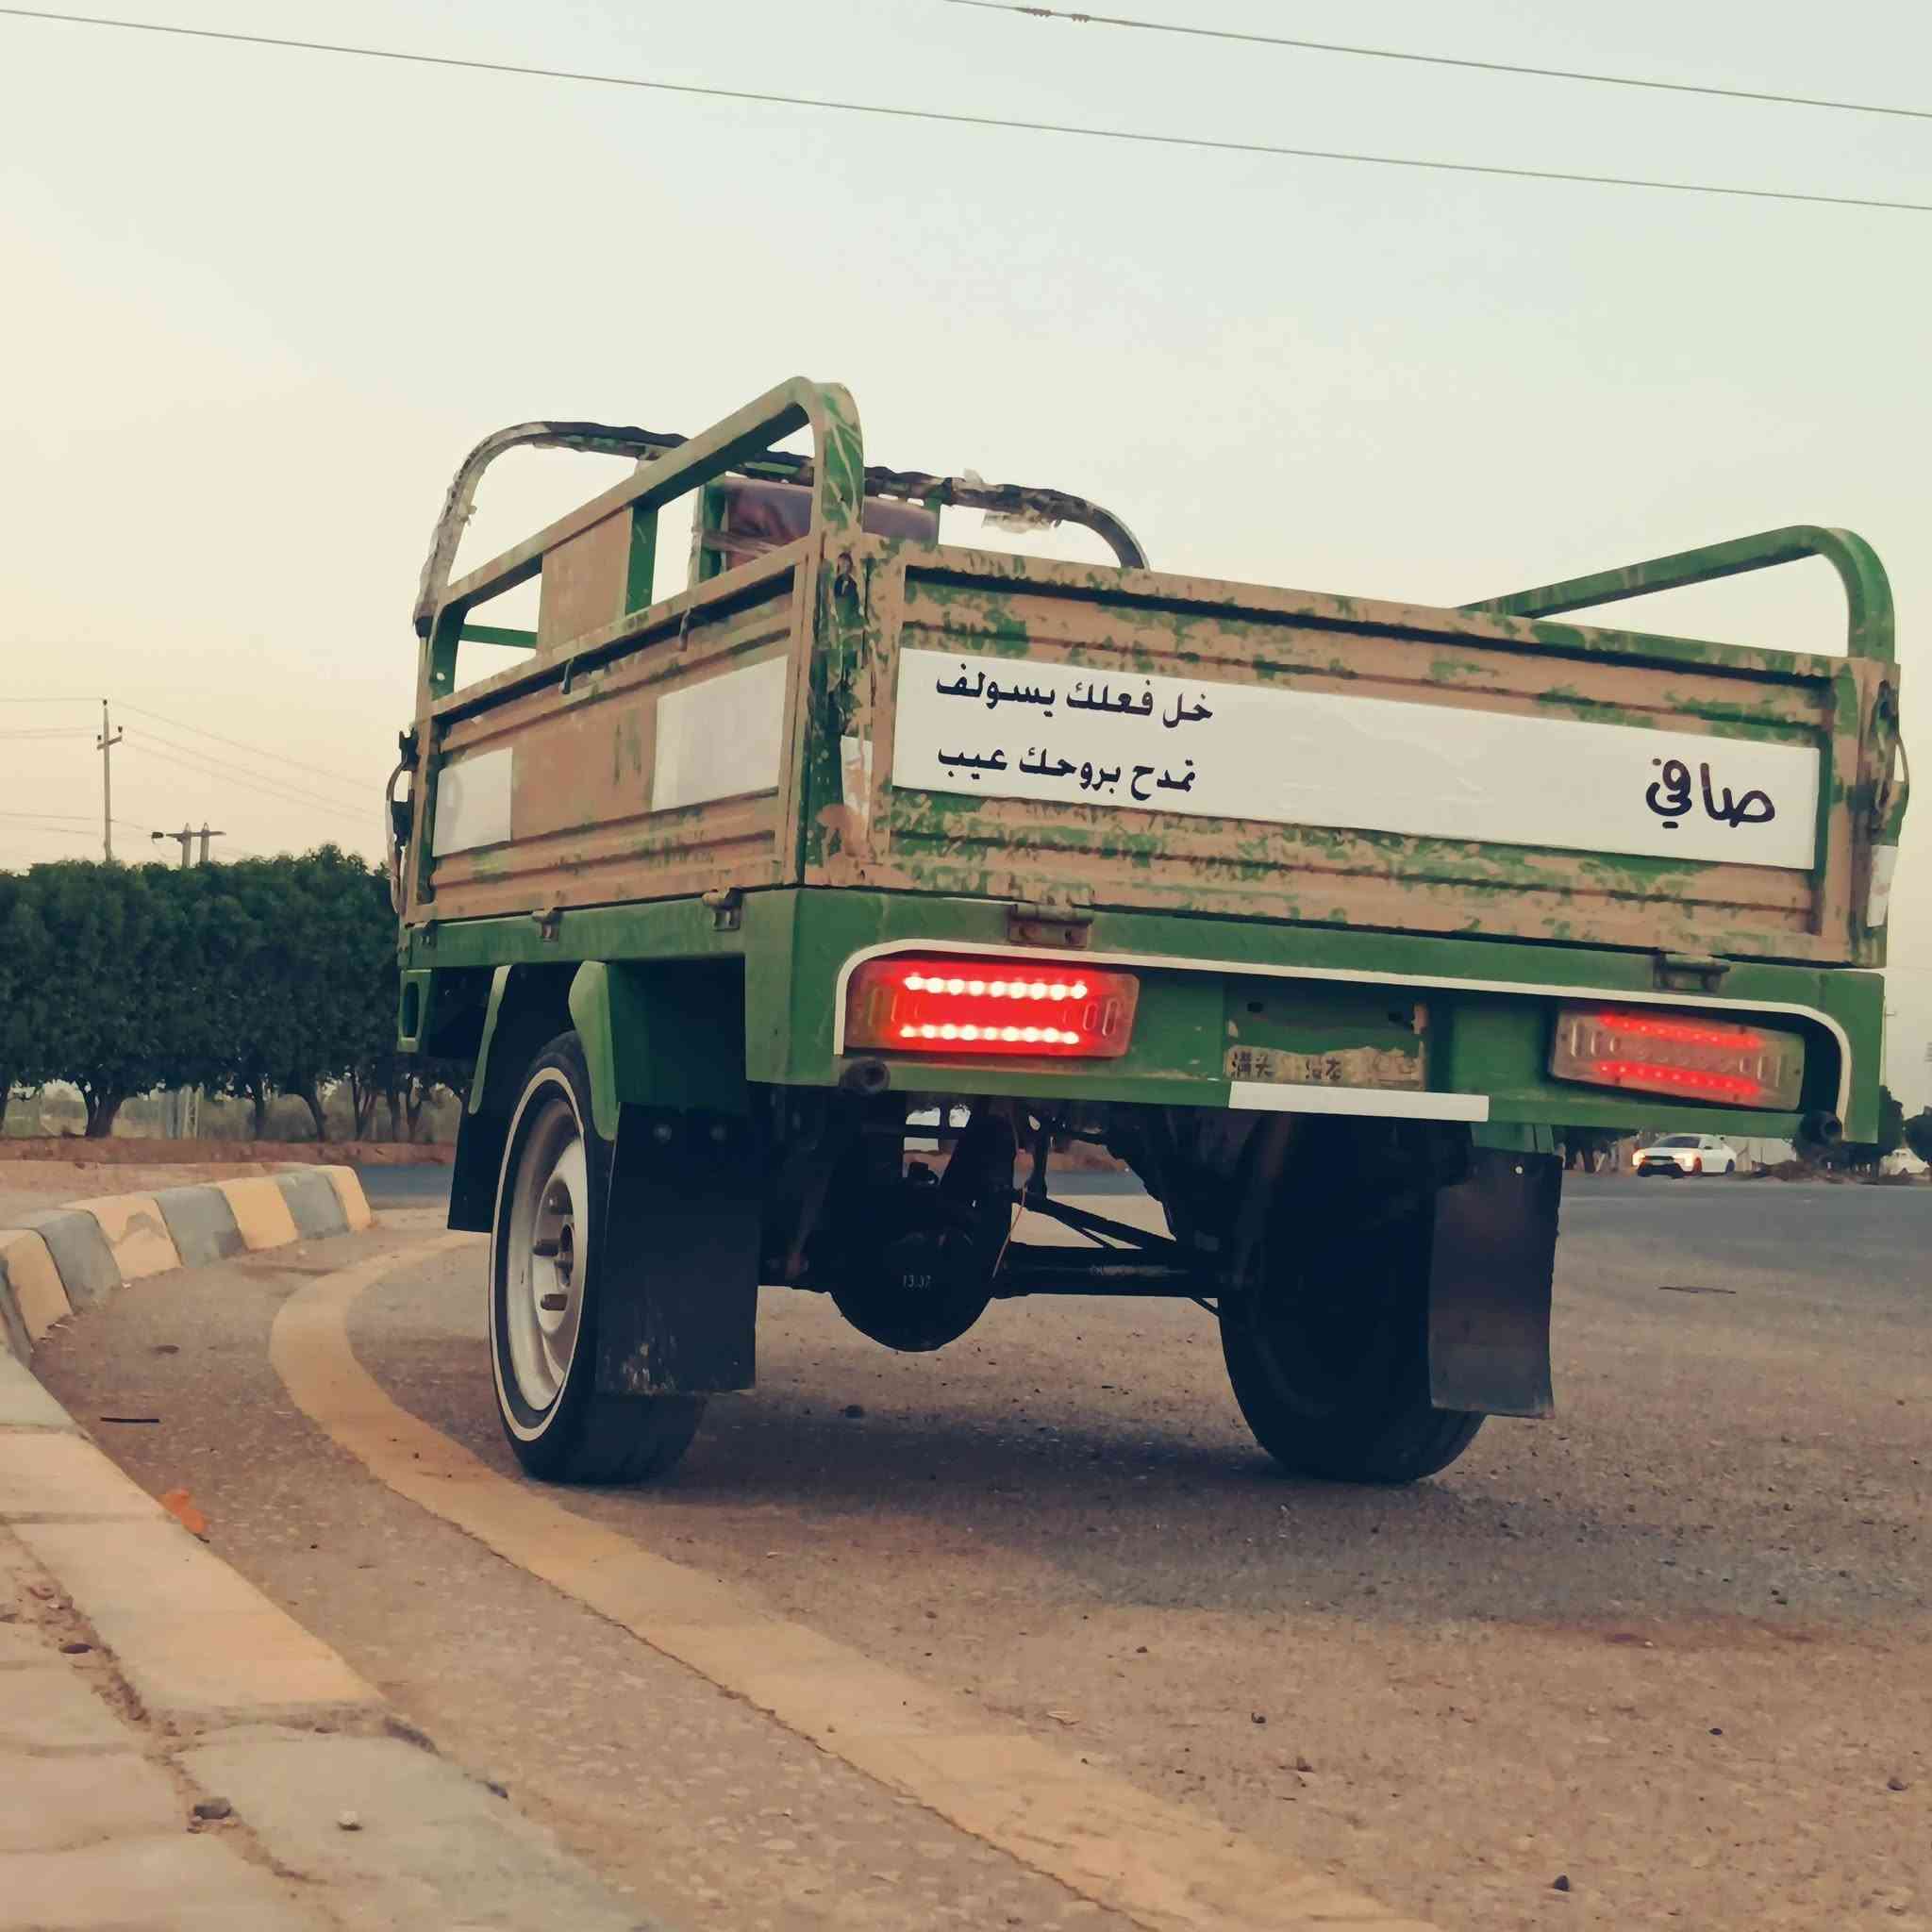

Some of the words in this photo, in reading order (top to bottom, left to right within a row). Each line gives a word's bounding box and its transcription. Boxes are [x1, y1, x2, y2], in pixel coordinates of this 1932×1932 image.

[935, 662, 1056, 718] يسولف
[1066, 678, 1154, 716] فعلك
[1162, 692, 1213, 728] خل
[938, 746, 1008, 780] عيب
[1019, 746, 1121, 794] بروحك
[1130, 758, 1196, 801] تمدح
[1645, 758, 1775, 829] صافي
